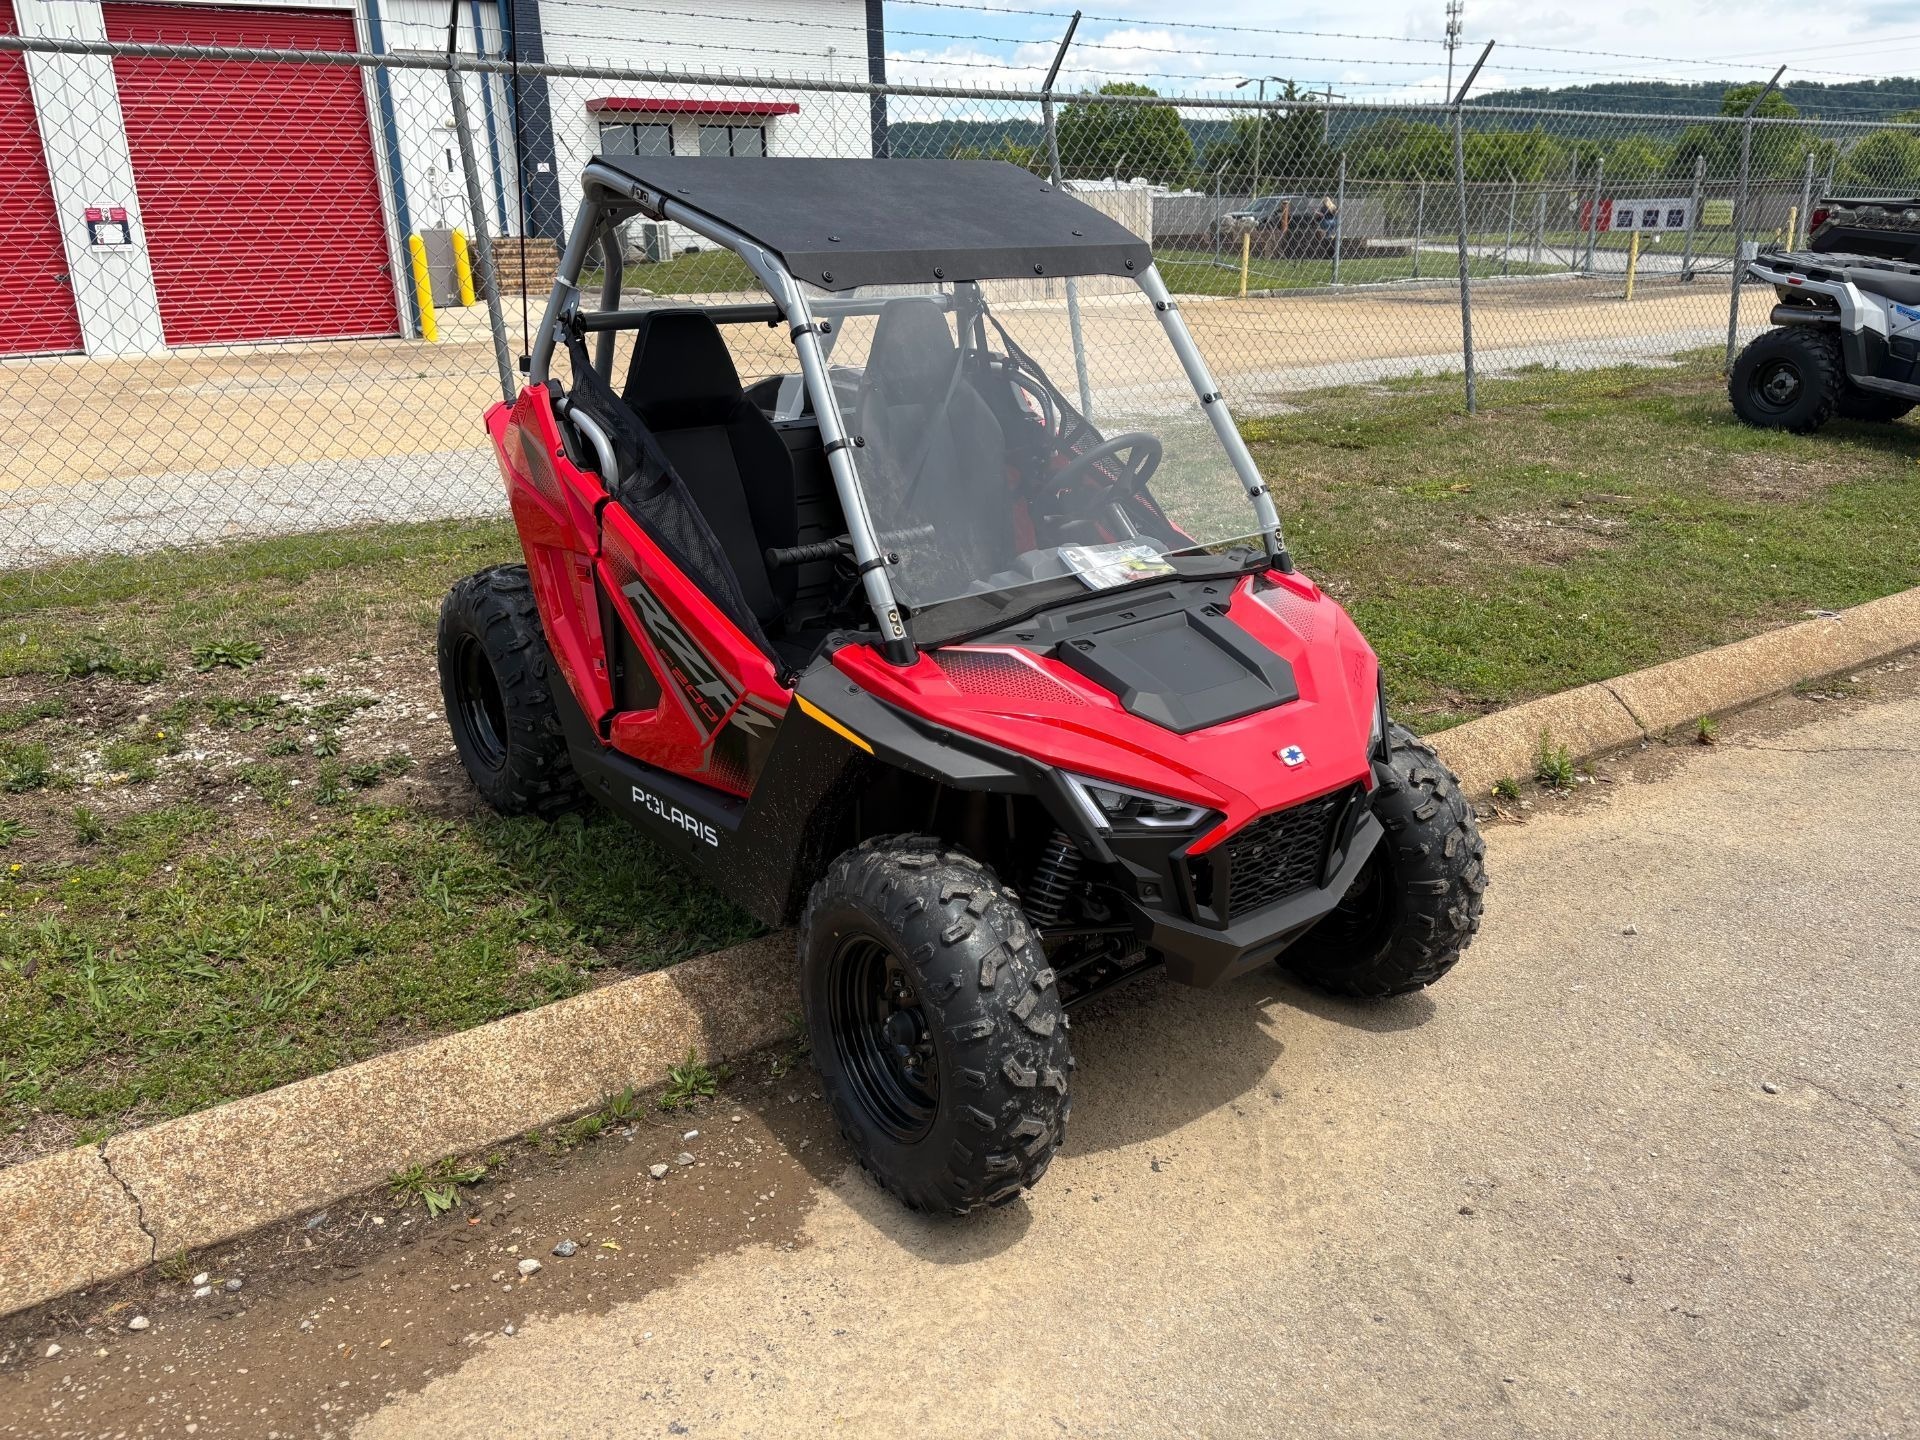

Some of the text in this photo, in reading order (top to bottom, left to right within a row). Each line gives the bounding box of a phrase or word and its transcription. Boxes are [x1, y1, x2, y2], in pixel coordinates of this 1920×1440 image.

[622, 581, 776, 738] RZR
[672, 666, 719, 722] 200
[632, 785, 719, 847] POLARIS
